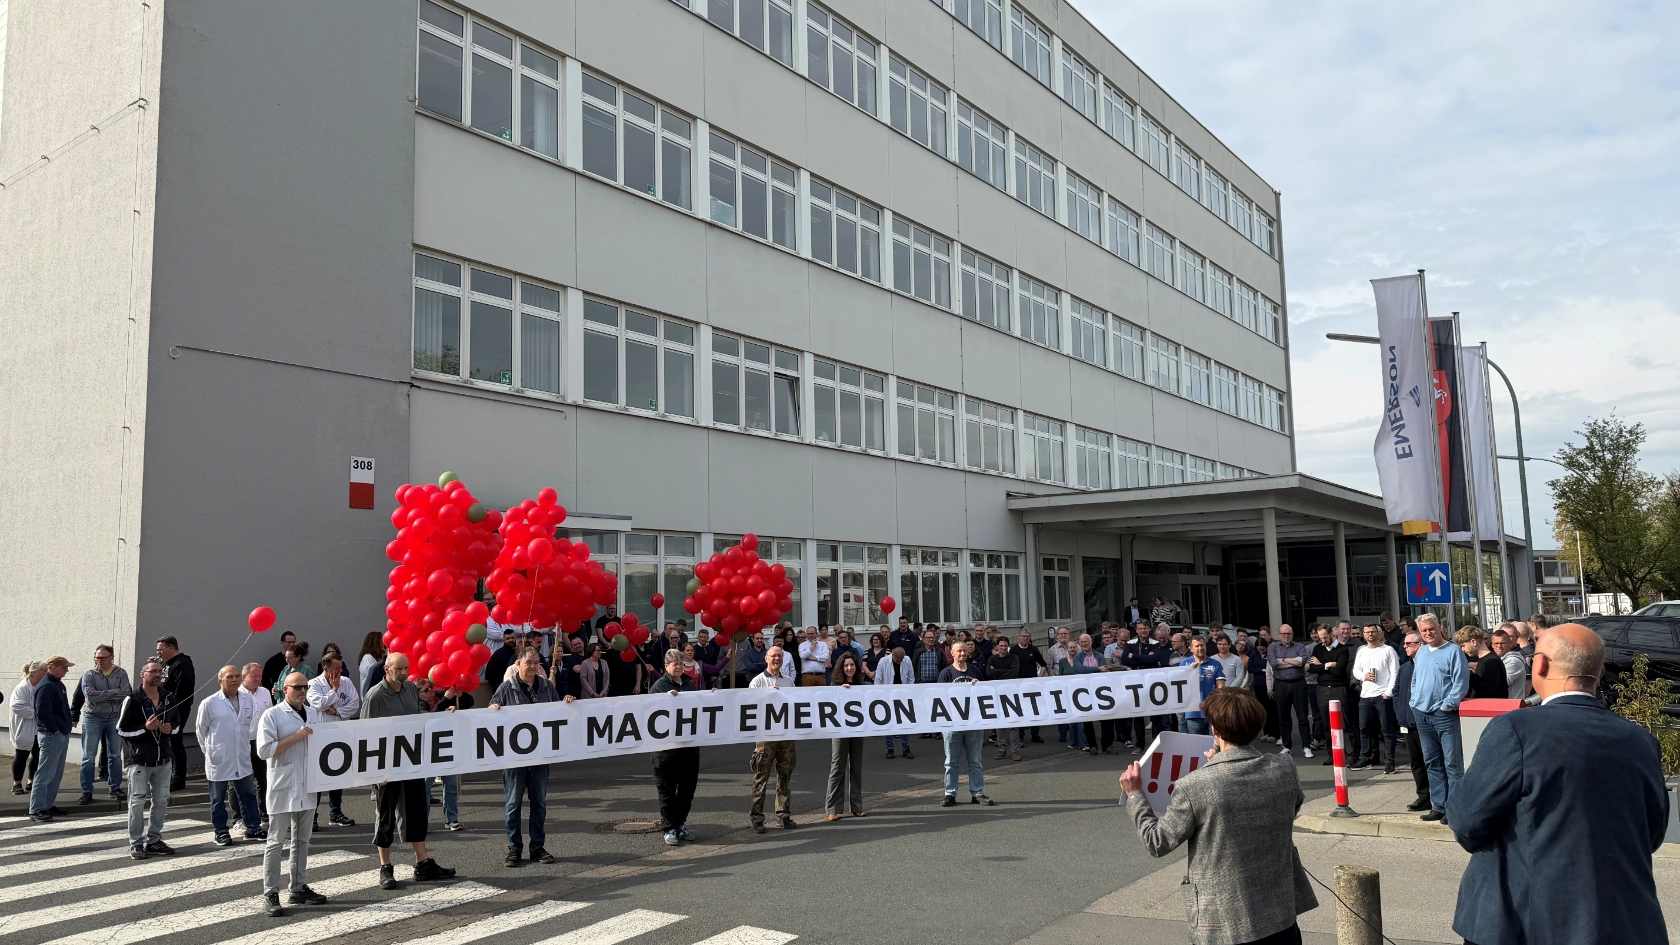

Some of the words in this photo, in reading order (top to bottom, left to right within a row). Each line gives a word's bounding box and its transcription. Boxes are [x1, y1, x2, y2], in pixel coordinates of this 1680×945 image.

[353, 459, 373, 471] 308
[318, 729, 454, 777] OHNE
[476, 719, 568, 760] NOT
[586, 705, 724, 747] MACHT
[739, 699, 917, 732] EMERSON
[930, 685, 1116, 723] AVENTICS
[1125, 679, 1188, 708] TOT
